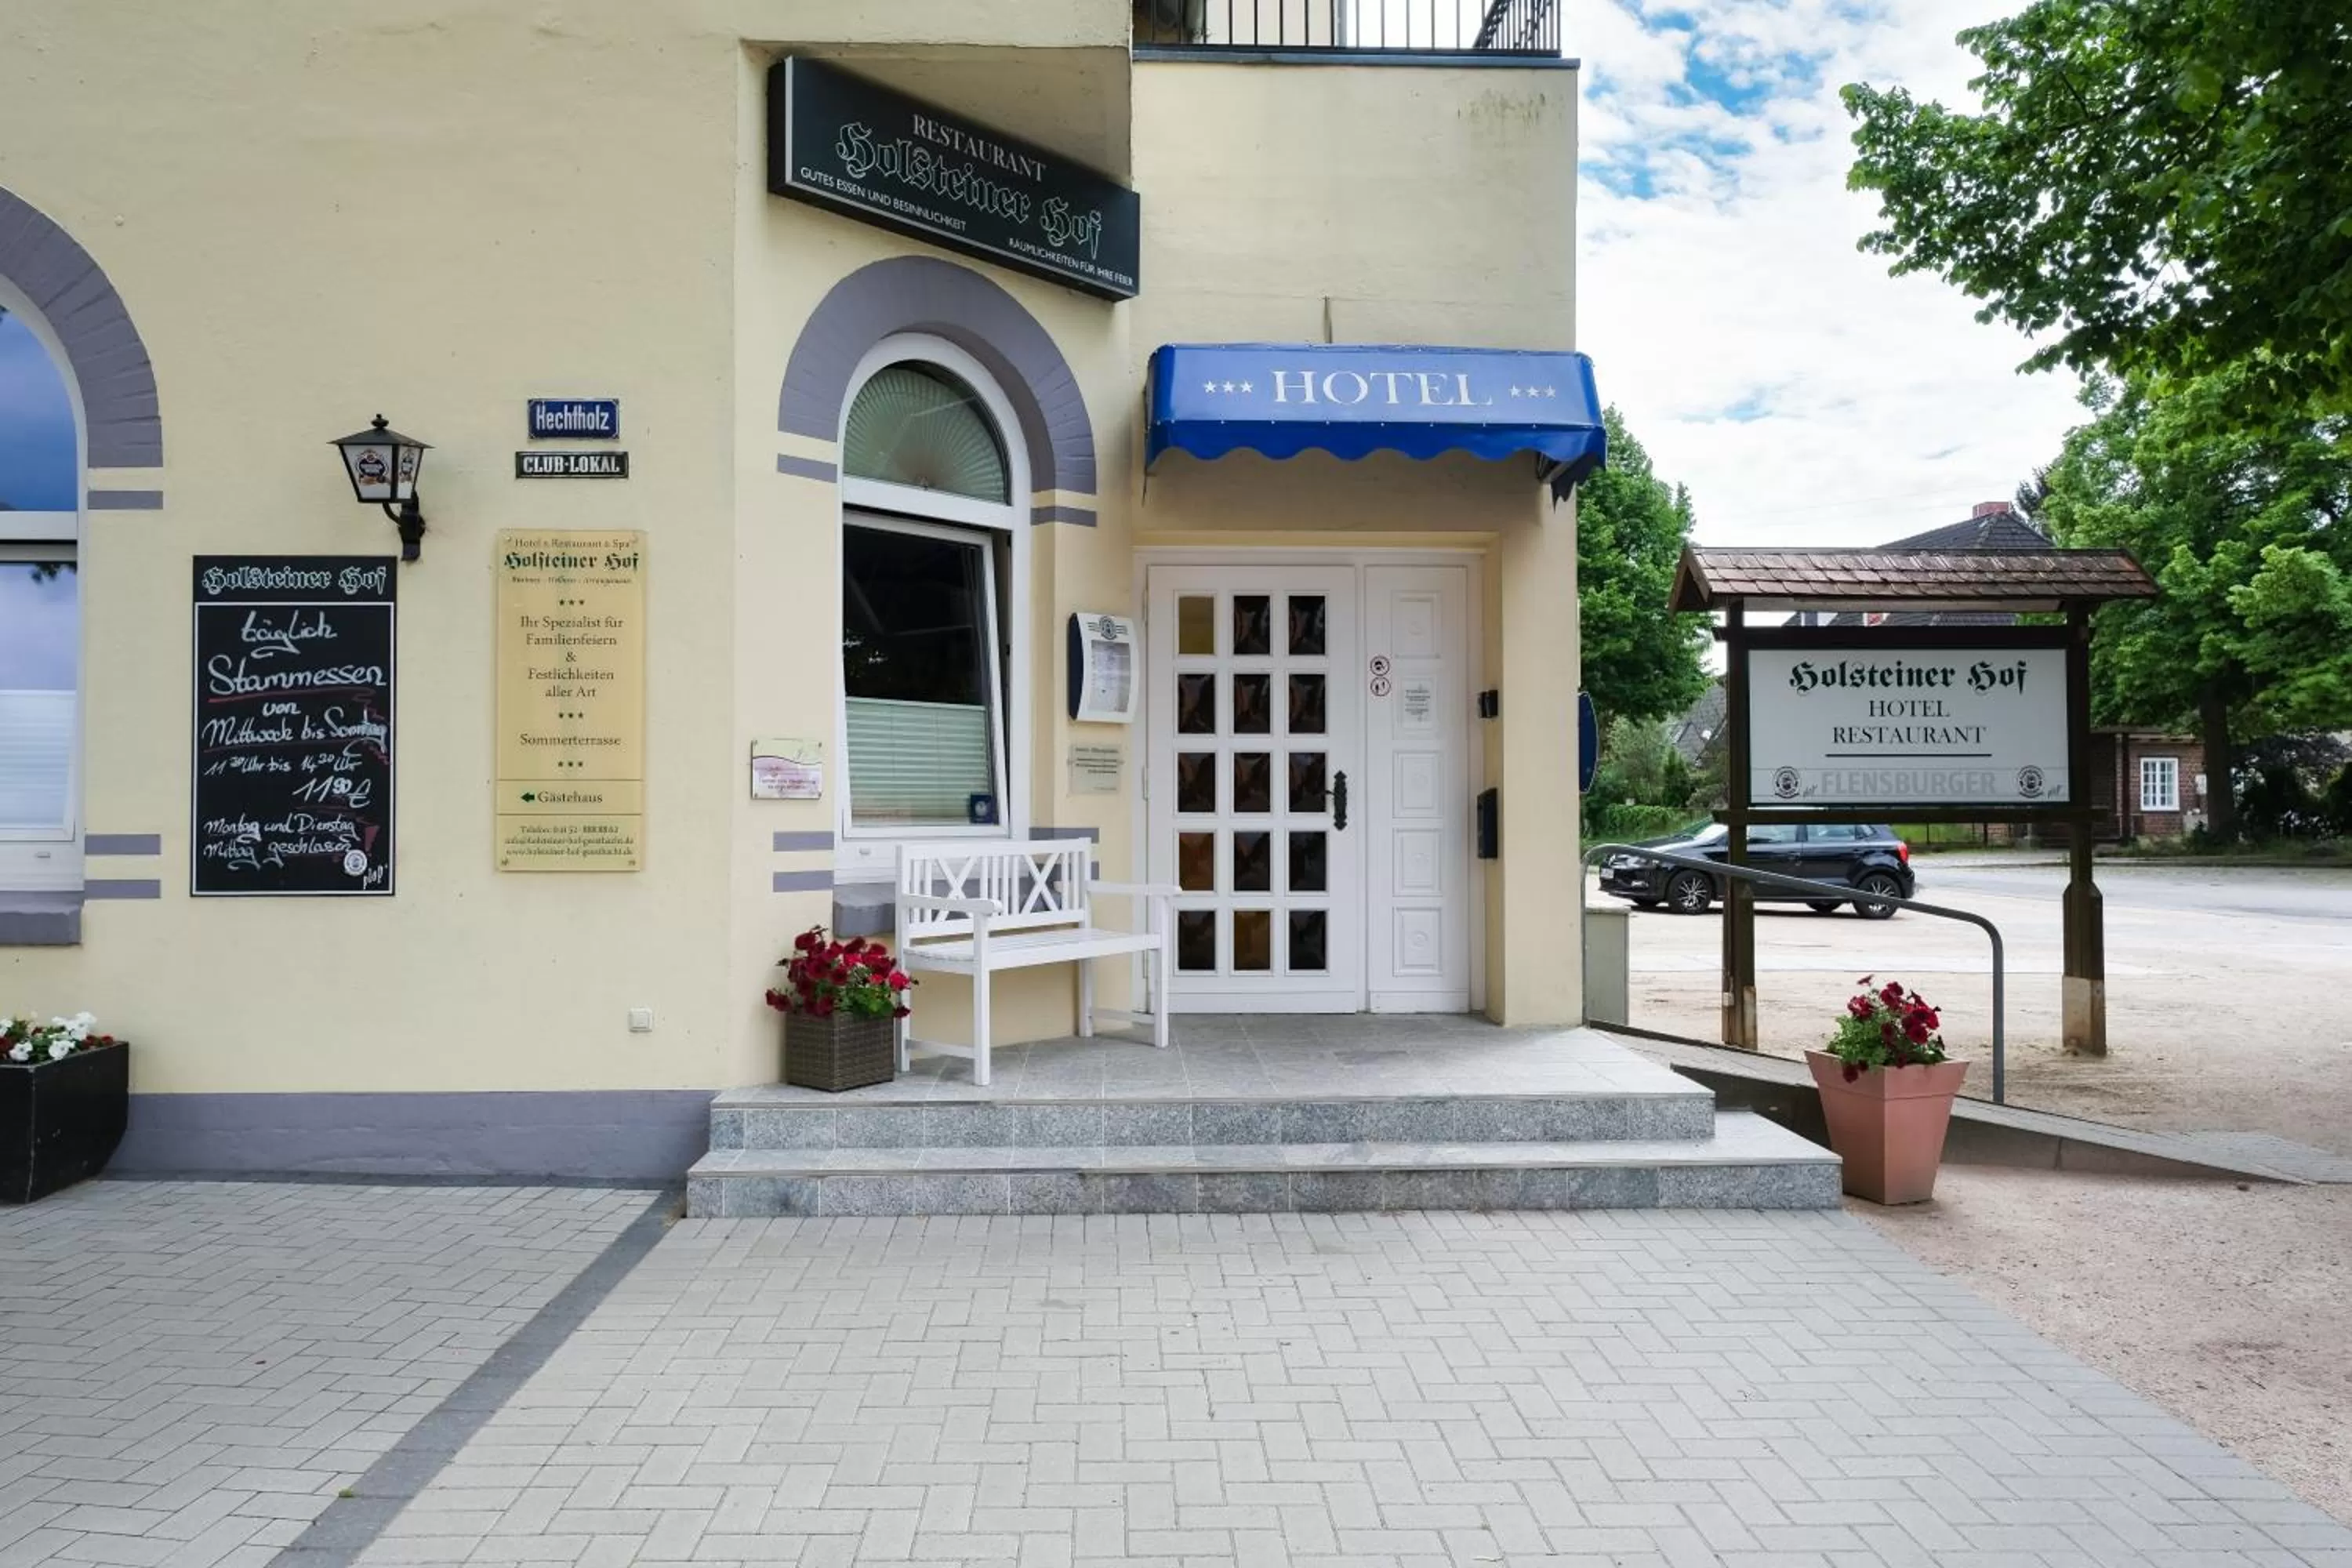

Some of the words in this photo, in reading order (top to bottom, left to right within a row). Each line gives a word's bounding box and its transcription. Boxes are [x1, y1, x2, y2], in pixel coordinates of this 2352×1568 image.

[912, 114, 1046, 183] RESTAURANT
[800, 167, 834, 187] GUTES
[837, 179, 866, 197] ESSEN
[868, 190, 891, 206] UND
[893, 198, 967, 231] BESINNLICHKEIT
[836, 122, 1031, 223] Holsteiner
[1040, 197, 1103, 260] Hof
[1272, 370, 1494, 406] HOTEL
[536, 403, 610, 431] Hechtholz
[515, 539, 540, 548] Hotel
[551, 539, 602, 548] Restaurant
[612, 539, 630, 551] Spa
[604, 552, 640, 572] Hof
[201, 565, 332, 596] Holsteiner
[338, 565, 387, 596] Hof
[241, 609, 338, 659] täglich
[521, 615, 539, 628] Ihr
[542, 615, 601, 631] Spezialist
[604, 615, 625, 628] für
[526, 633, 618, 645] Familienfeiern
[565, 652, 577, 662] &
[208, 654, 387, 695] Stammessen
[528, 667, 615, 680] Festlichkeiten
[1788, 660, 1957, 696] Holsteiner
[1967, 660, 2027, 696] Hof
[545, 684, 572, 697] aller
[576, 685, 597, 697] Art
[263, 702, 302, 717] von
[1868, 700, 1951, 717] HOTEL
[201, 715, 294, 746] Mittwoch
[301, 715, 327, 739] bis
[324, 706, 388, 756] Sonntag
[520, 733, 622, 746] Sommerterrasse
[1832, 726, 1987, 745] RESTAURANT
[267, 755, 292, 772] bis
[1821, 771, 1997, 795] FLENSBURGER
[537, 789, 603, 804] Gästehaus
[204, 812, 262, 844] Montag
[264, 811, 294, 833] und
[294, 812, 361, 842] Dienstag
[204, 838, 261, 870] Mittag
